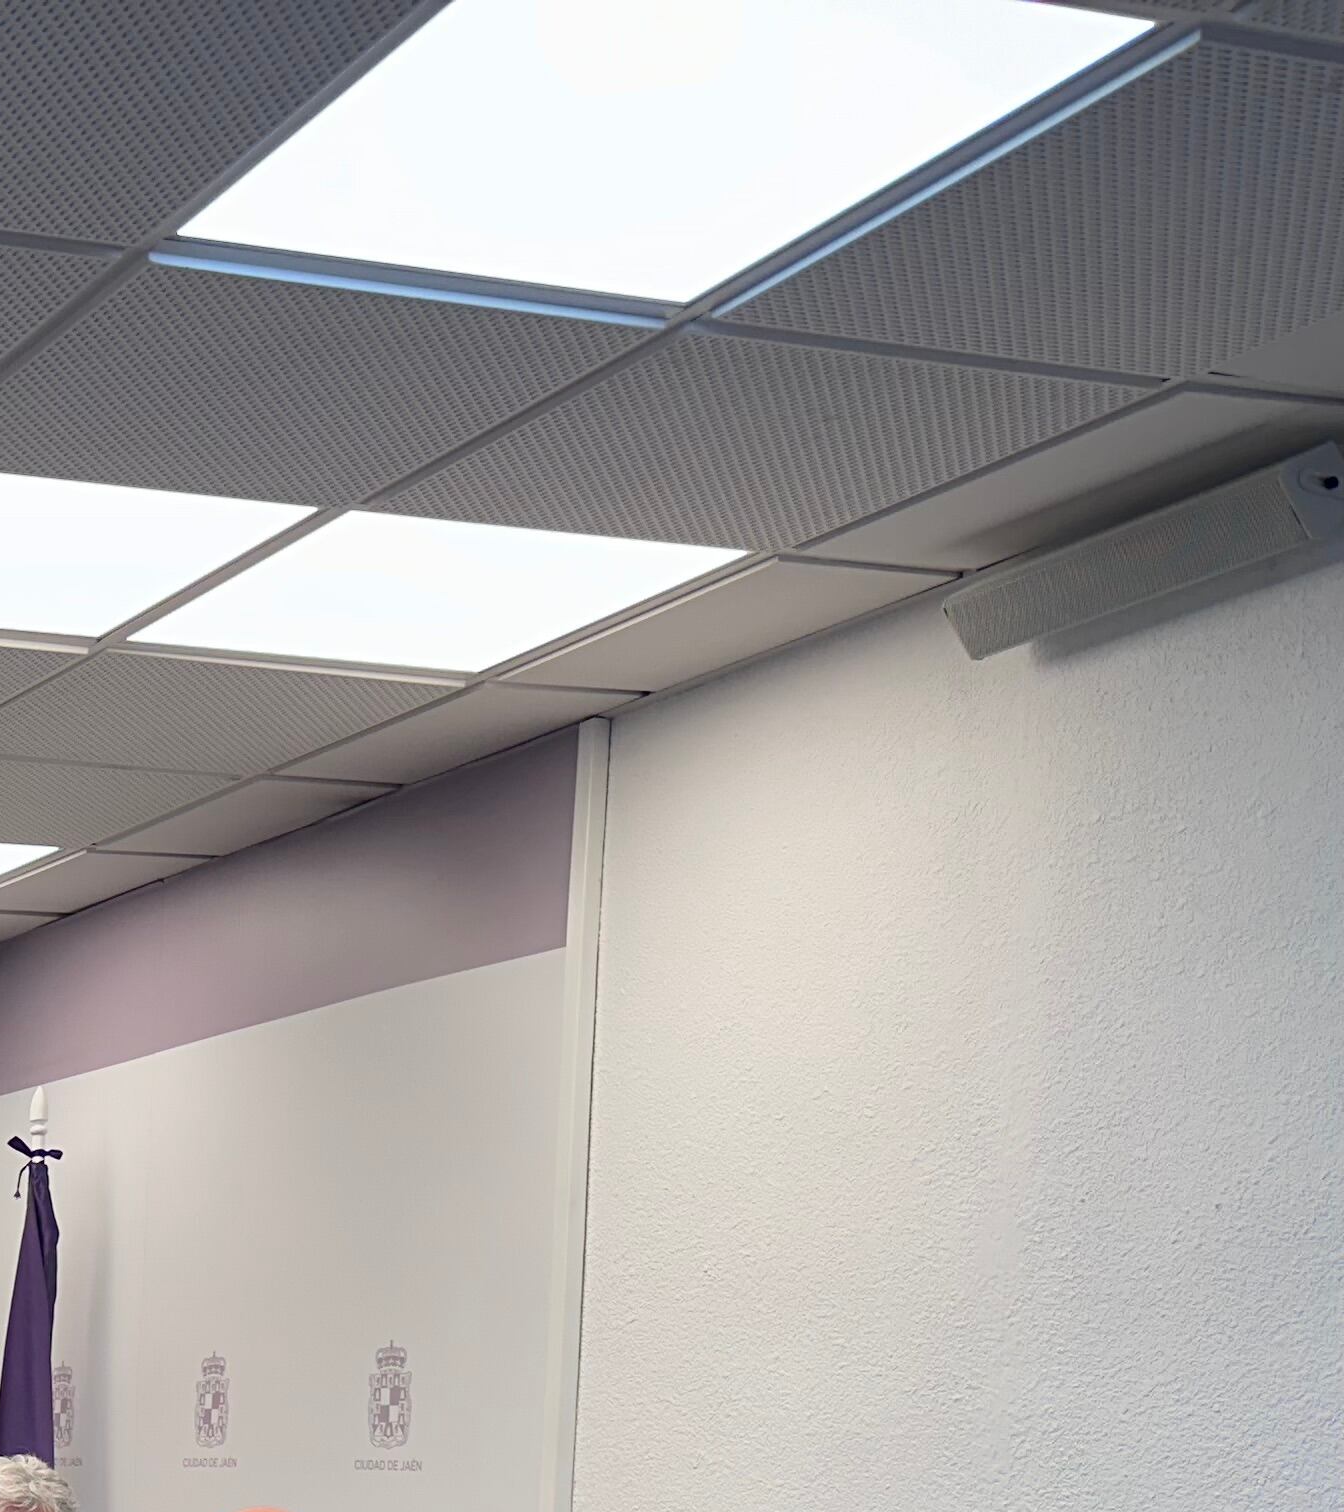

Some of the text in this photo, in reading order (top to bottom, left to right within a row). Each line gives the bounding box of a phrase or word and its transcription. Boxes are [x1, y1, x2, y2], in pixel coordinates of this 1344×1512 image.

[182, 1458, 208, 1468] CIUDAD
[354, 1459, 423, 1472] CIUDAD DE JAÉN
